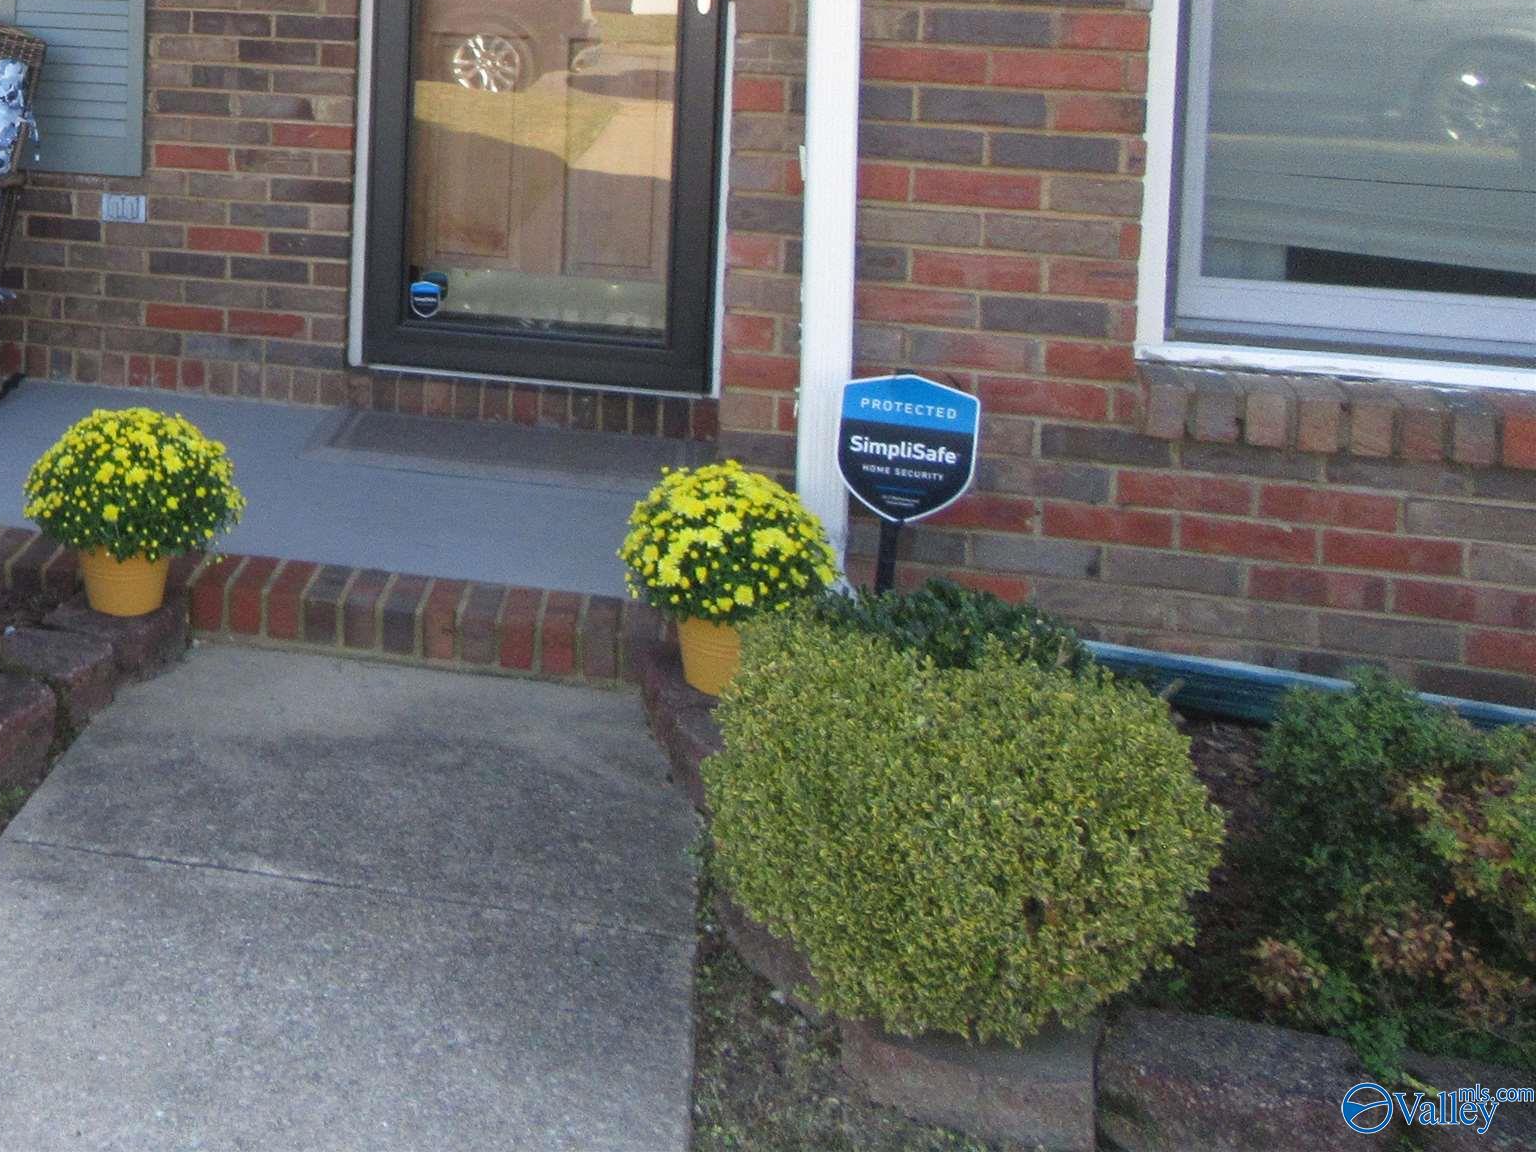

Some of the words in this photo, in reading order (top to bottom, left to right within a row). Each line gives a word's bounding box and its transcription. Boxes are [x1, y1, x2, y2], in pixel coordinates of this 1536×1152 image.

[860, 397, 957, 420] PROTECTED
[849, 435, 957, 464] SimpliSafe
[862, 464, 890, 475] HOME
[893, 467, 944, 481] SECURITY
